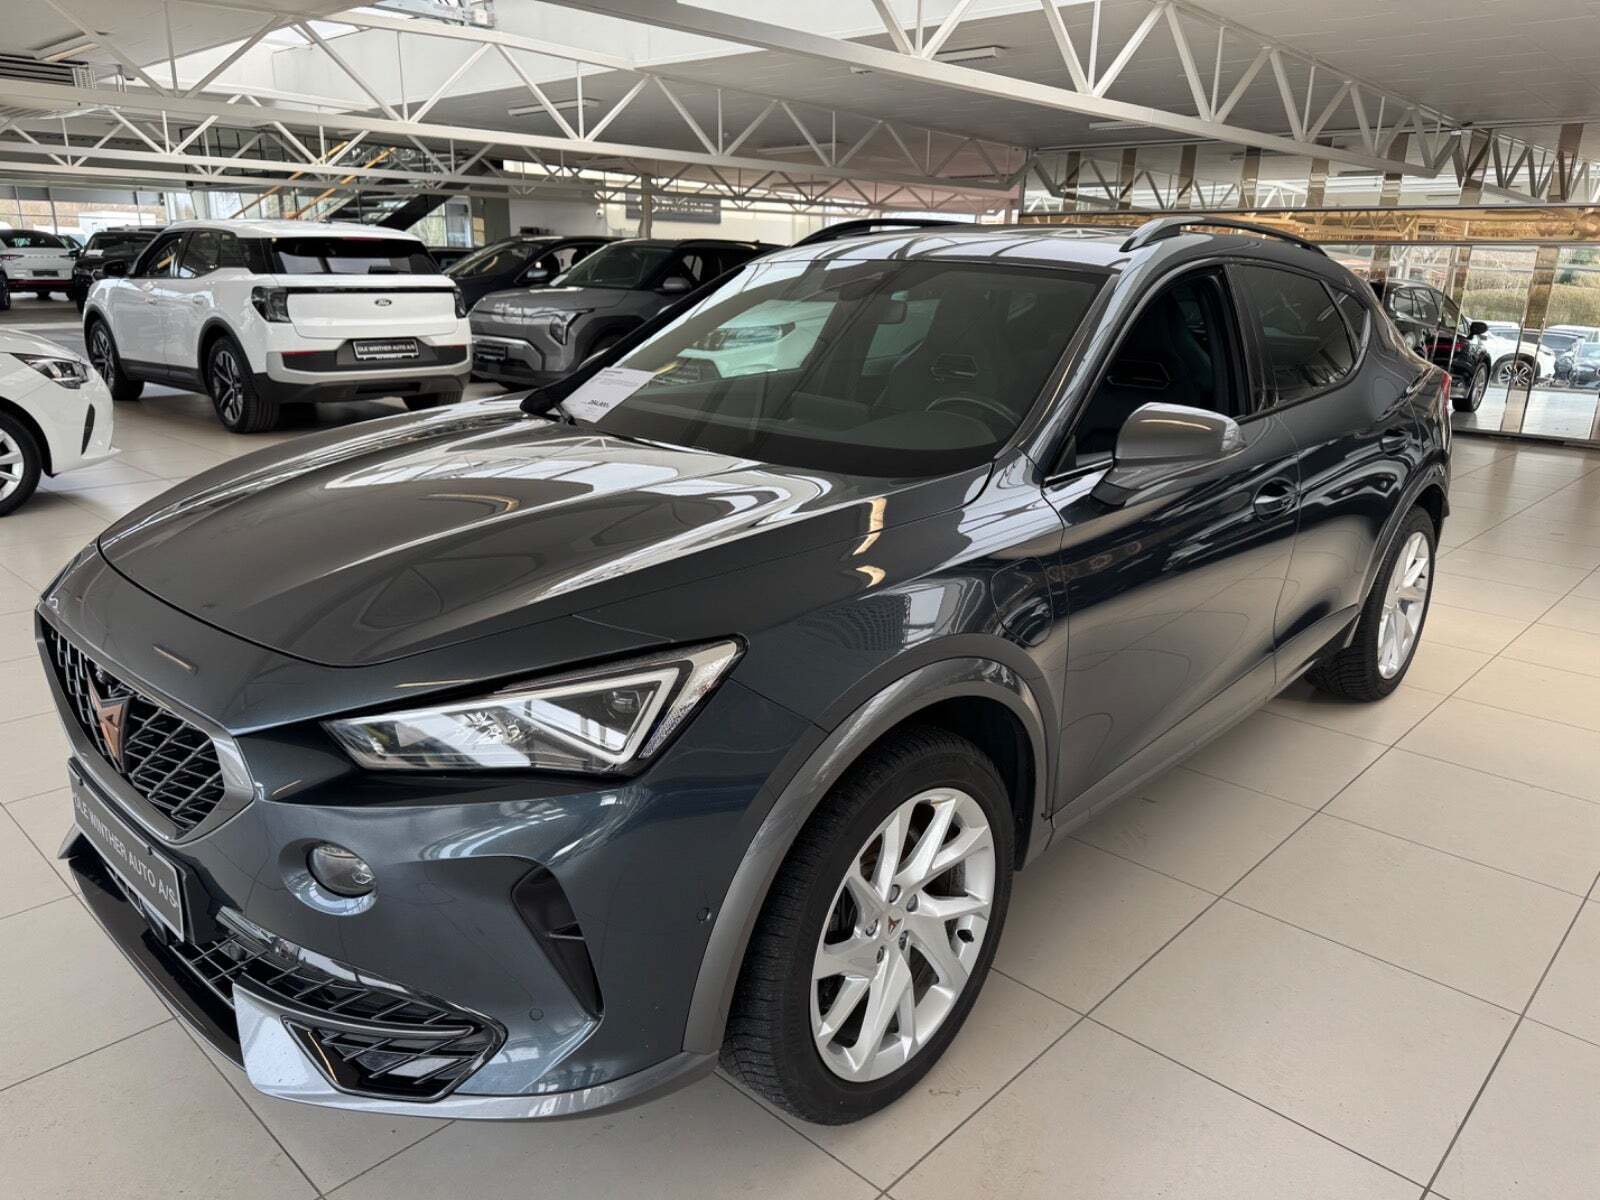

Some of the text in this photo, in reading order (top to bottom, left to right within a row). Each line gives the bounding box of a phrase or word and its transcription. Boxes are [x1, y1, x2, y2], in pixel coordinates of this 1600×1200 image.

[90, 812, 128, 860] WINTHER
[129, 851, 156, 888] AUTO
[158, 879, 177, 908] A/S
